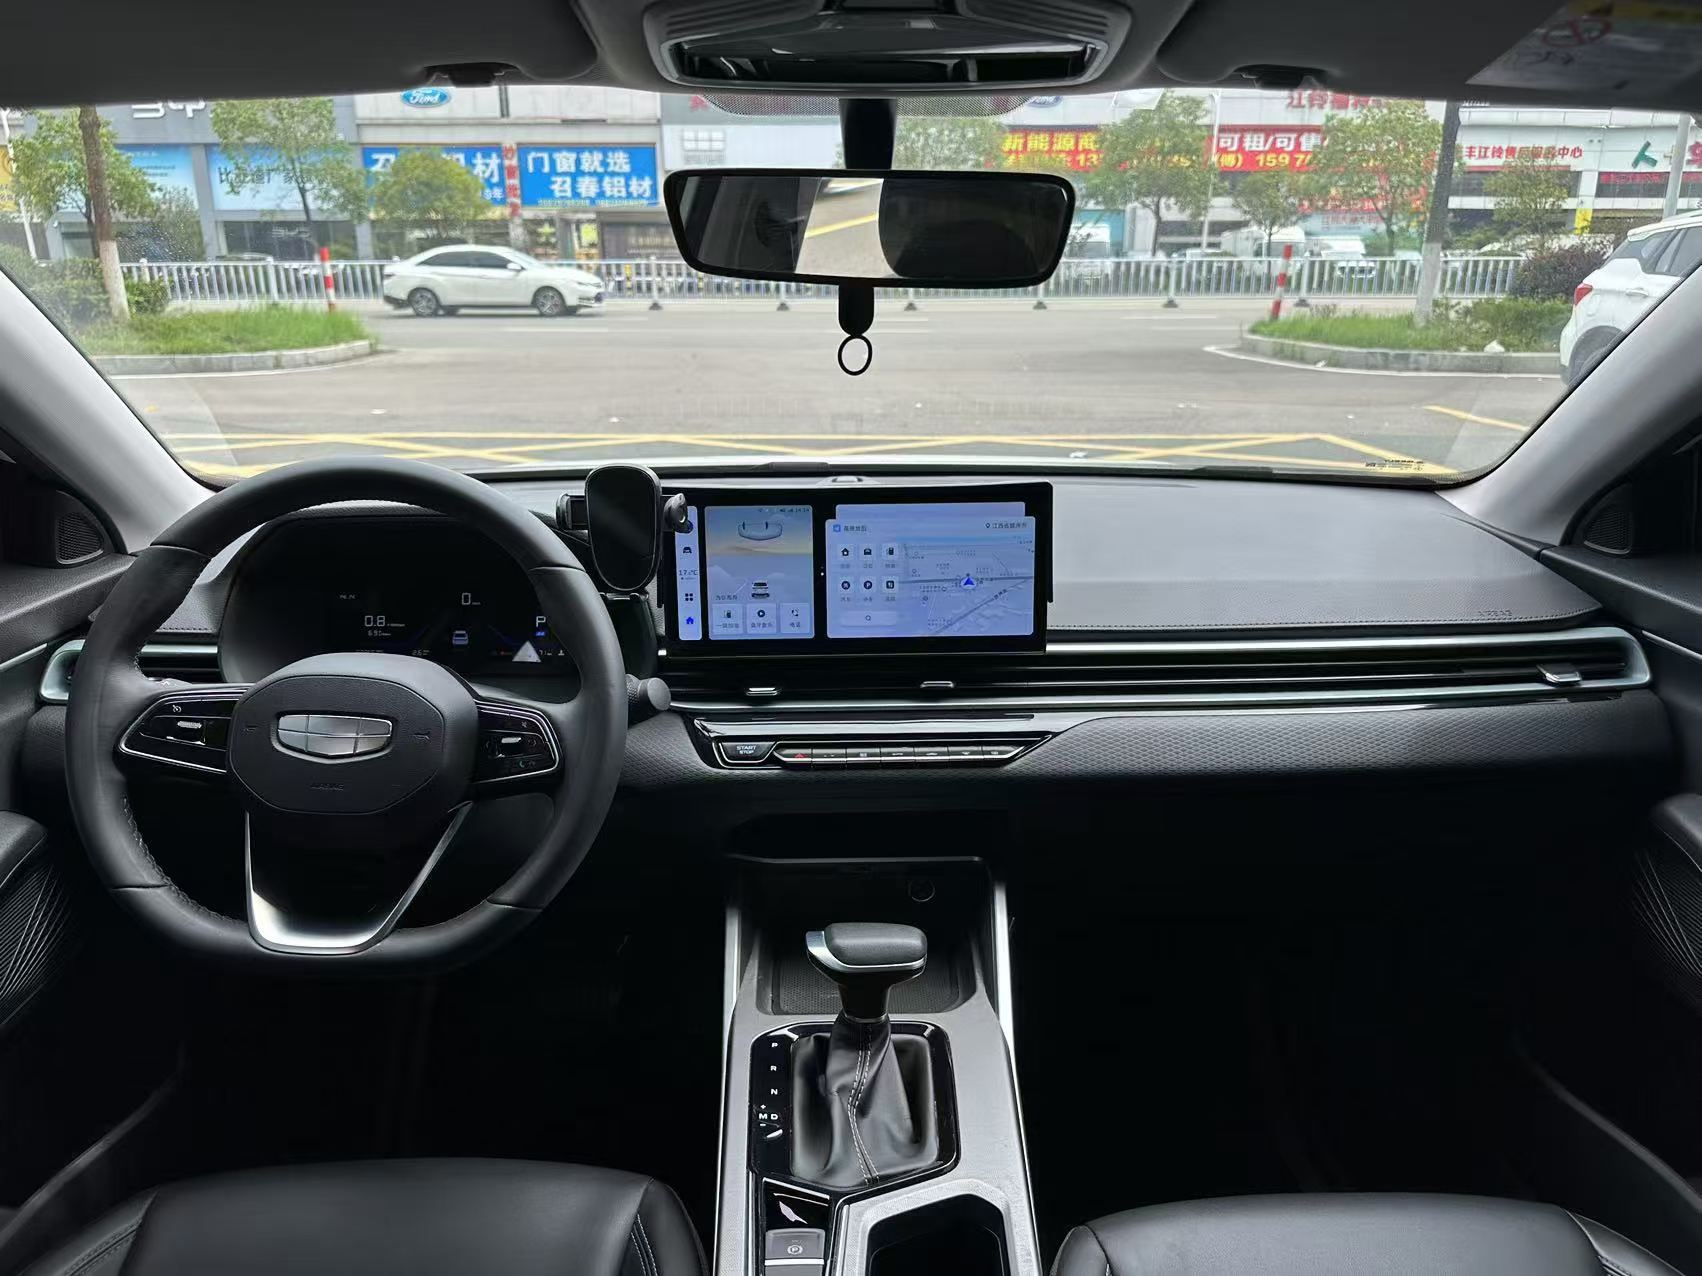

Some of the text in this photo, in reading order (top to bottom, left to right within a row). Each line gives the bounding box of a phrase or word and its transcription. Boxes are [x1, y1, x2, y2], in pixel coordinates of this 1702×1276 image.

[408, 91, 441, 104] Ford
[526, 151, 632, 174] 门窗就选
[1256, 153, 1290, 168] 159
[549, 175, 653, 199] 召春铝材
[462, 592, 471, 605] 0
[364, 615, 386, 627] 0.8
[536, 616, 546, 627] P
